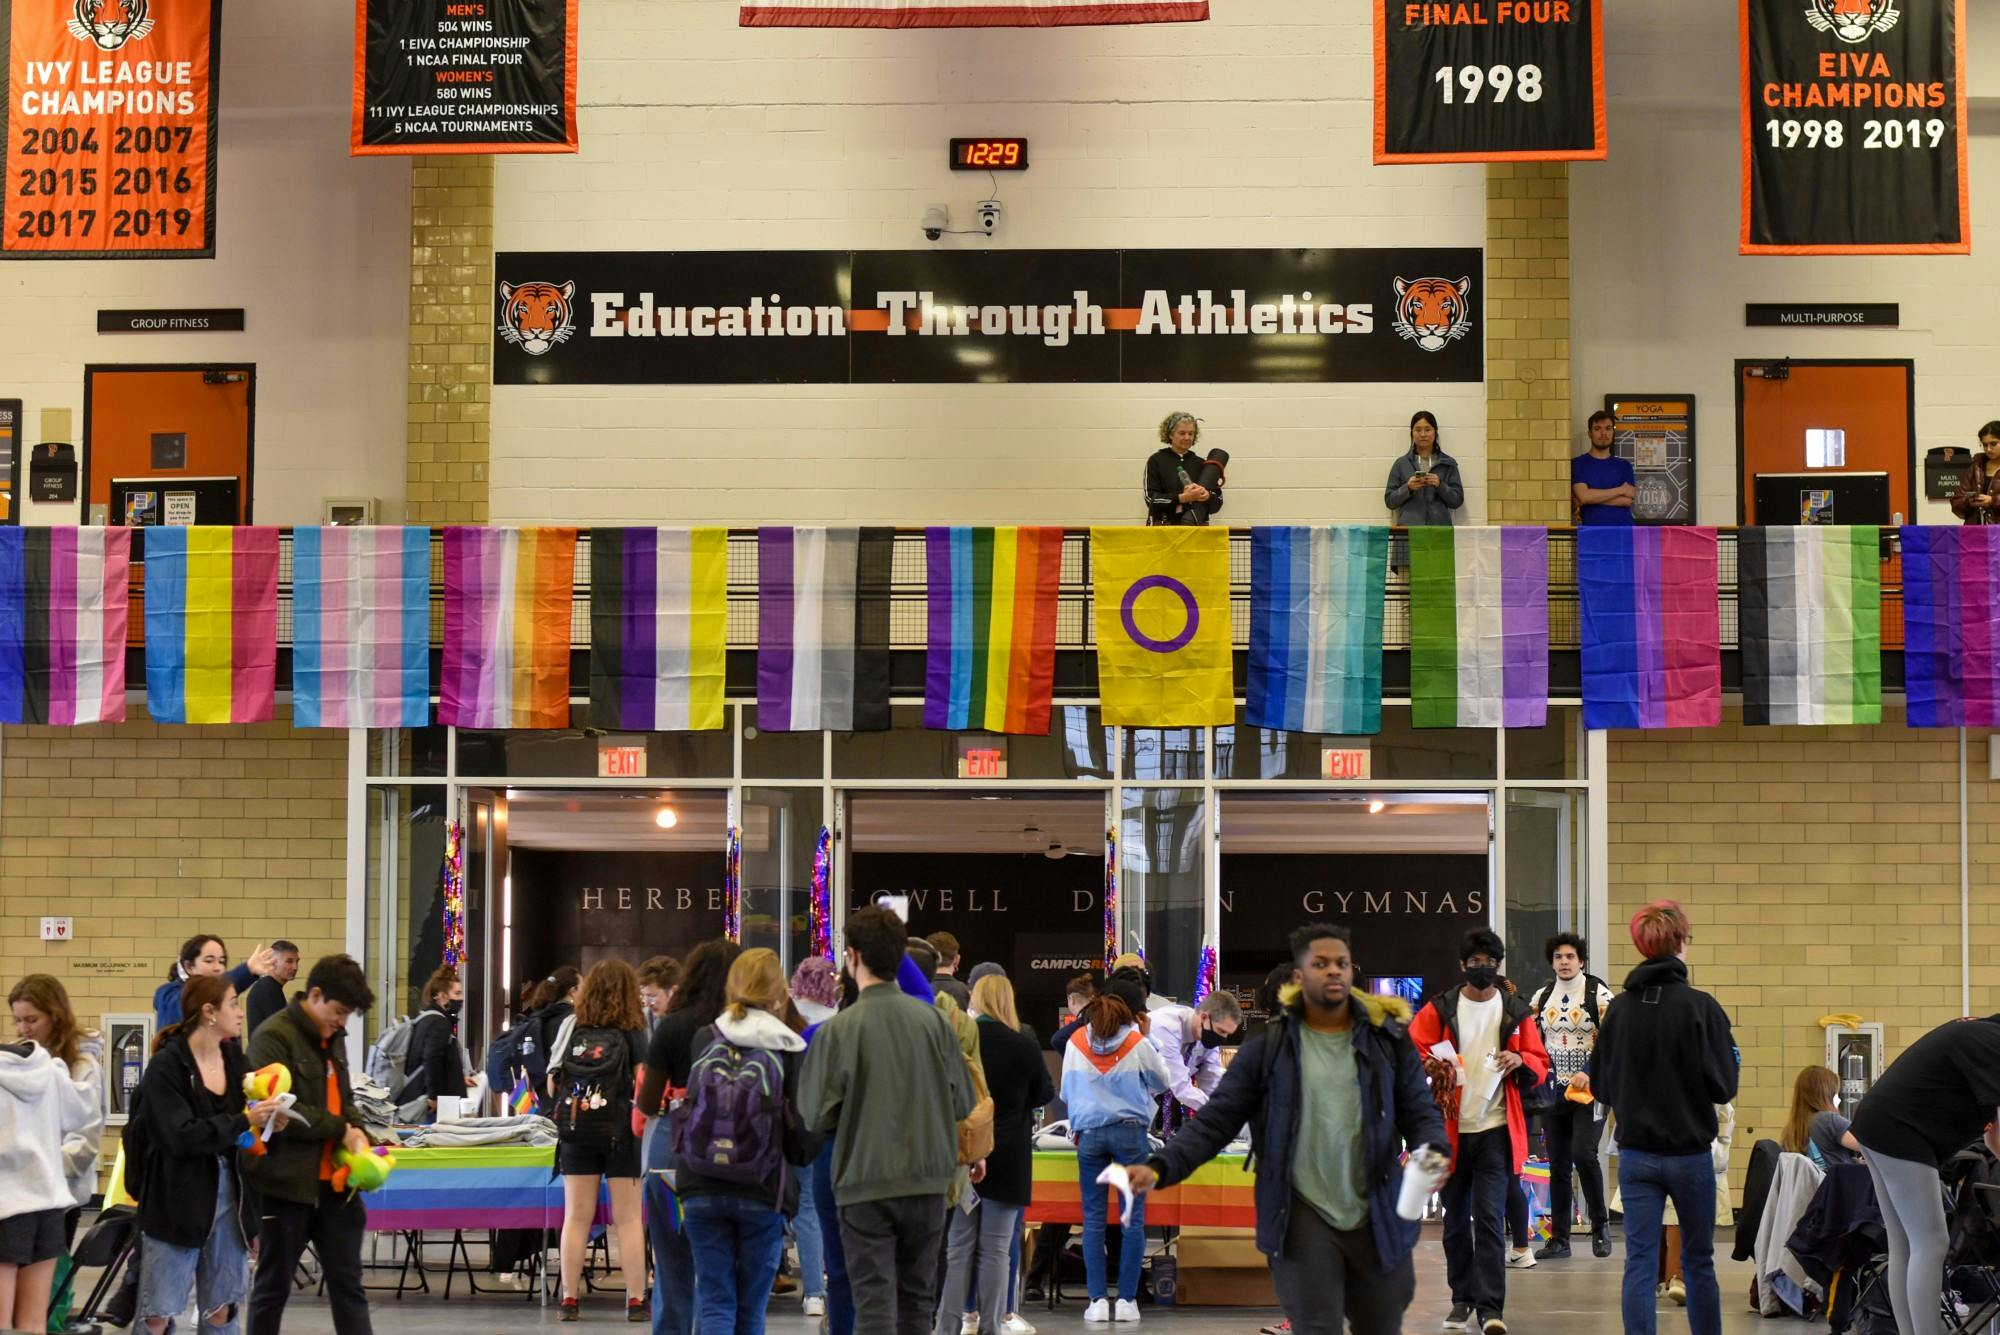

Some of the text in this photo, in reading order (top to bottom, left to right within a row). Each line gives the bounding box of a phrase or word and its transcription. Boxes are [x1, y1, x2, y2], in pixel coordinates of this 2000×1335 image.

[447, 4, 485, 16] MEN'S
[1405, 1, 1570, 26] FINAL FOUR
[438, 20, 493, 33] 504 WINS
[400, 37, 531, 50] 1 EIVA CHAMPIONSHIP
[407, 53, 523, 66] 1 NCAA FINAL FOUR
[1819, 53, 1891, 78] EIVA
[26, 61, 192, 85] IVY LEAGUE
[435, 71, 494, 82] WOMEN'S
[1436, 64, 1543, 104] 1998
[22, 91, 195, 116] CHAMPIONS
[437, 87, 492, 99] 580 WINS
[1763, 82, 1946, 108] CHAMPIONS
[370, 104, 559, 118] 11 IVY LEAGUE CHAMPIONSHIPS
[394, 121, 533, 134] 5 NCAA TOURNAMENTS
[1766, 118, 1945, 149] 1998 2019
[21, 126, 193, 155] 2004 2007
[966, 143, 1019, 164] 12:29
[20, 167, 191, 196] 2015 2016
[18, 208, 191, 238] 2017 2019
[131, 318, 209, 328] GROUP FITNESS
[590, 289, 1374, 347] Education Through Athletics
[1780, 312, 1865, 323] MULTI-PURPOSE
[1635, 405, 1664, 413] YOGA
[1636, 490, 1667, 504] YOGA
[607, 749, 640, 775] EXIT
[967, 750, 1001, 775] EXIT
[1331, 752, 1363, 777] EXIT
[1302, 890, 1483, 914] GYMNAS
